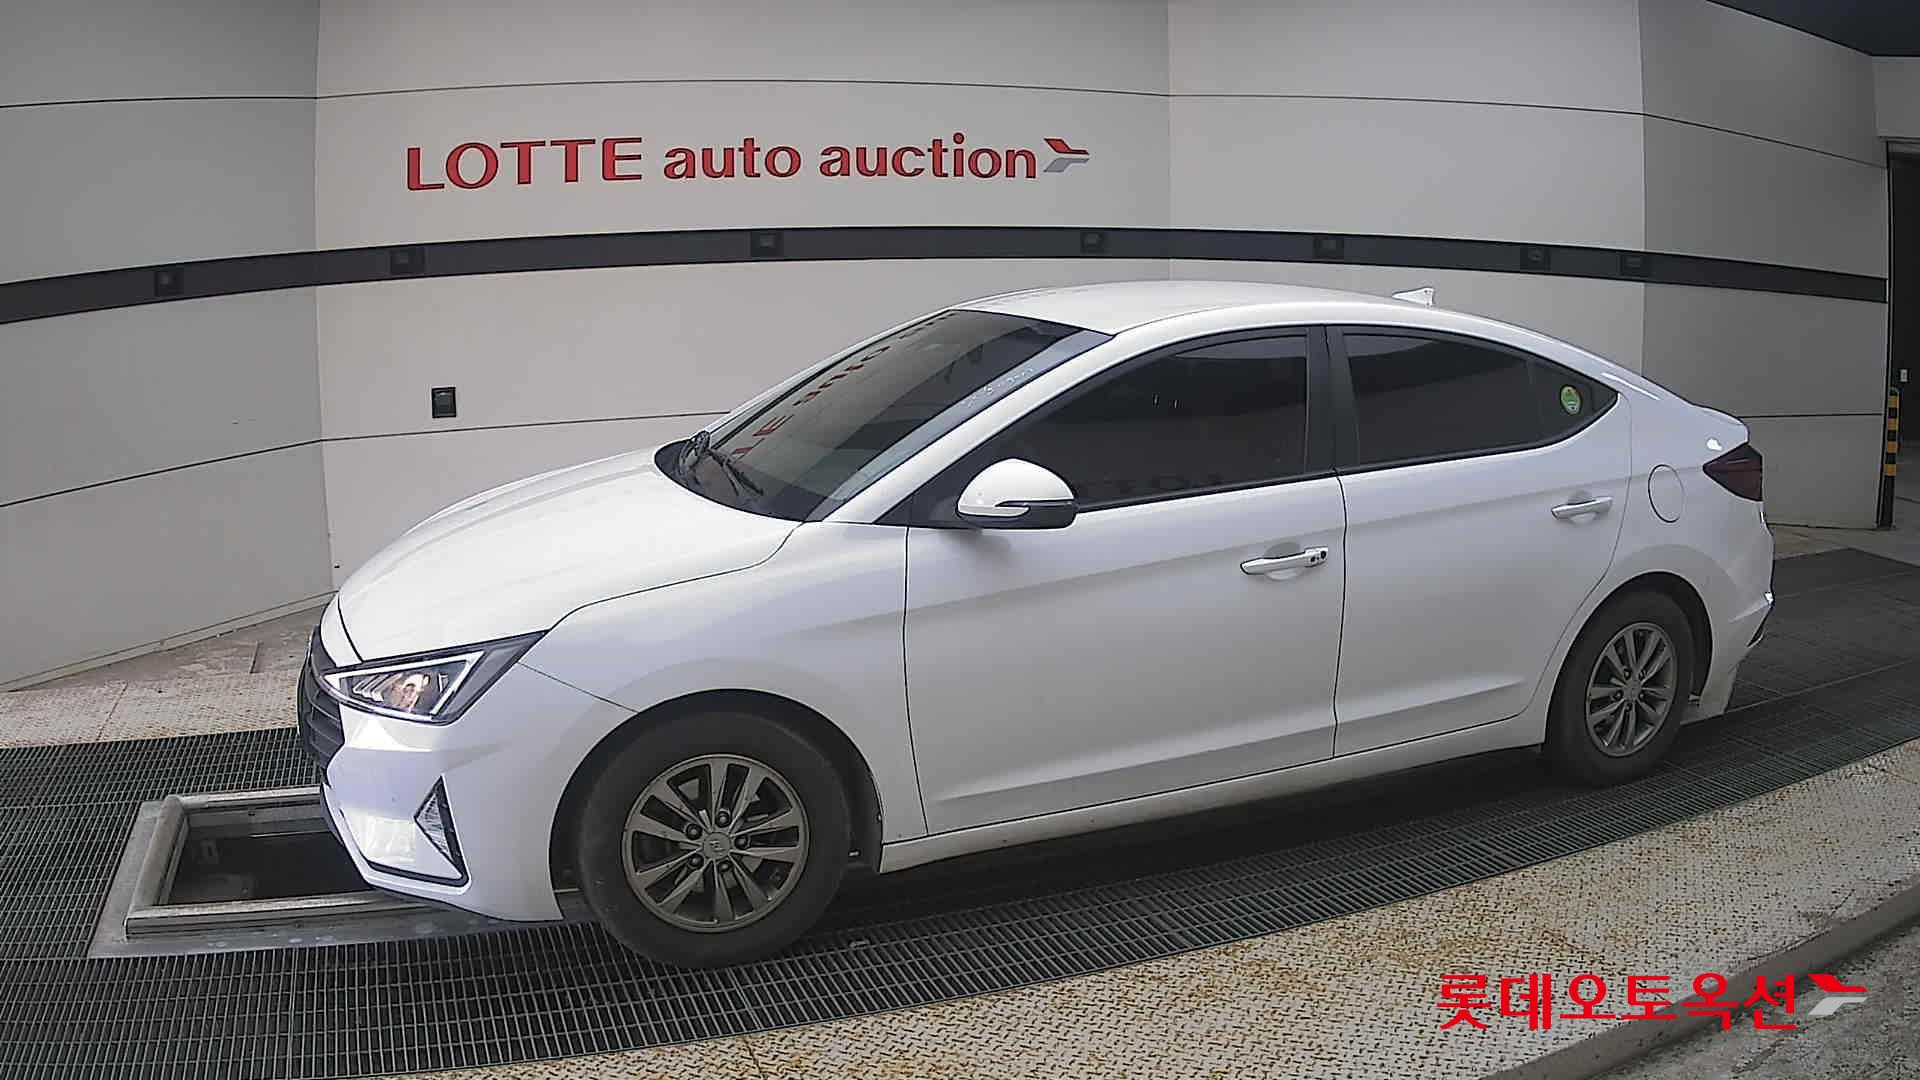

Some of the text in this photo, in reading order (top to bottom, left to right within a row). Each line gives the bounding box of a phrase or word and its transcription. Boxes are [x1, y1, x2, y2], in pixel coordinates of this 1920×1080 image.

[406, 132, 1037, 190] LOTTE auto auction
